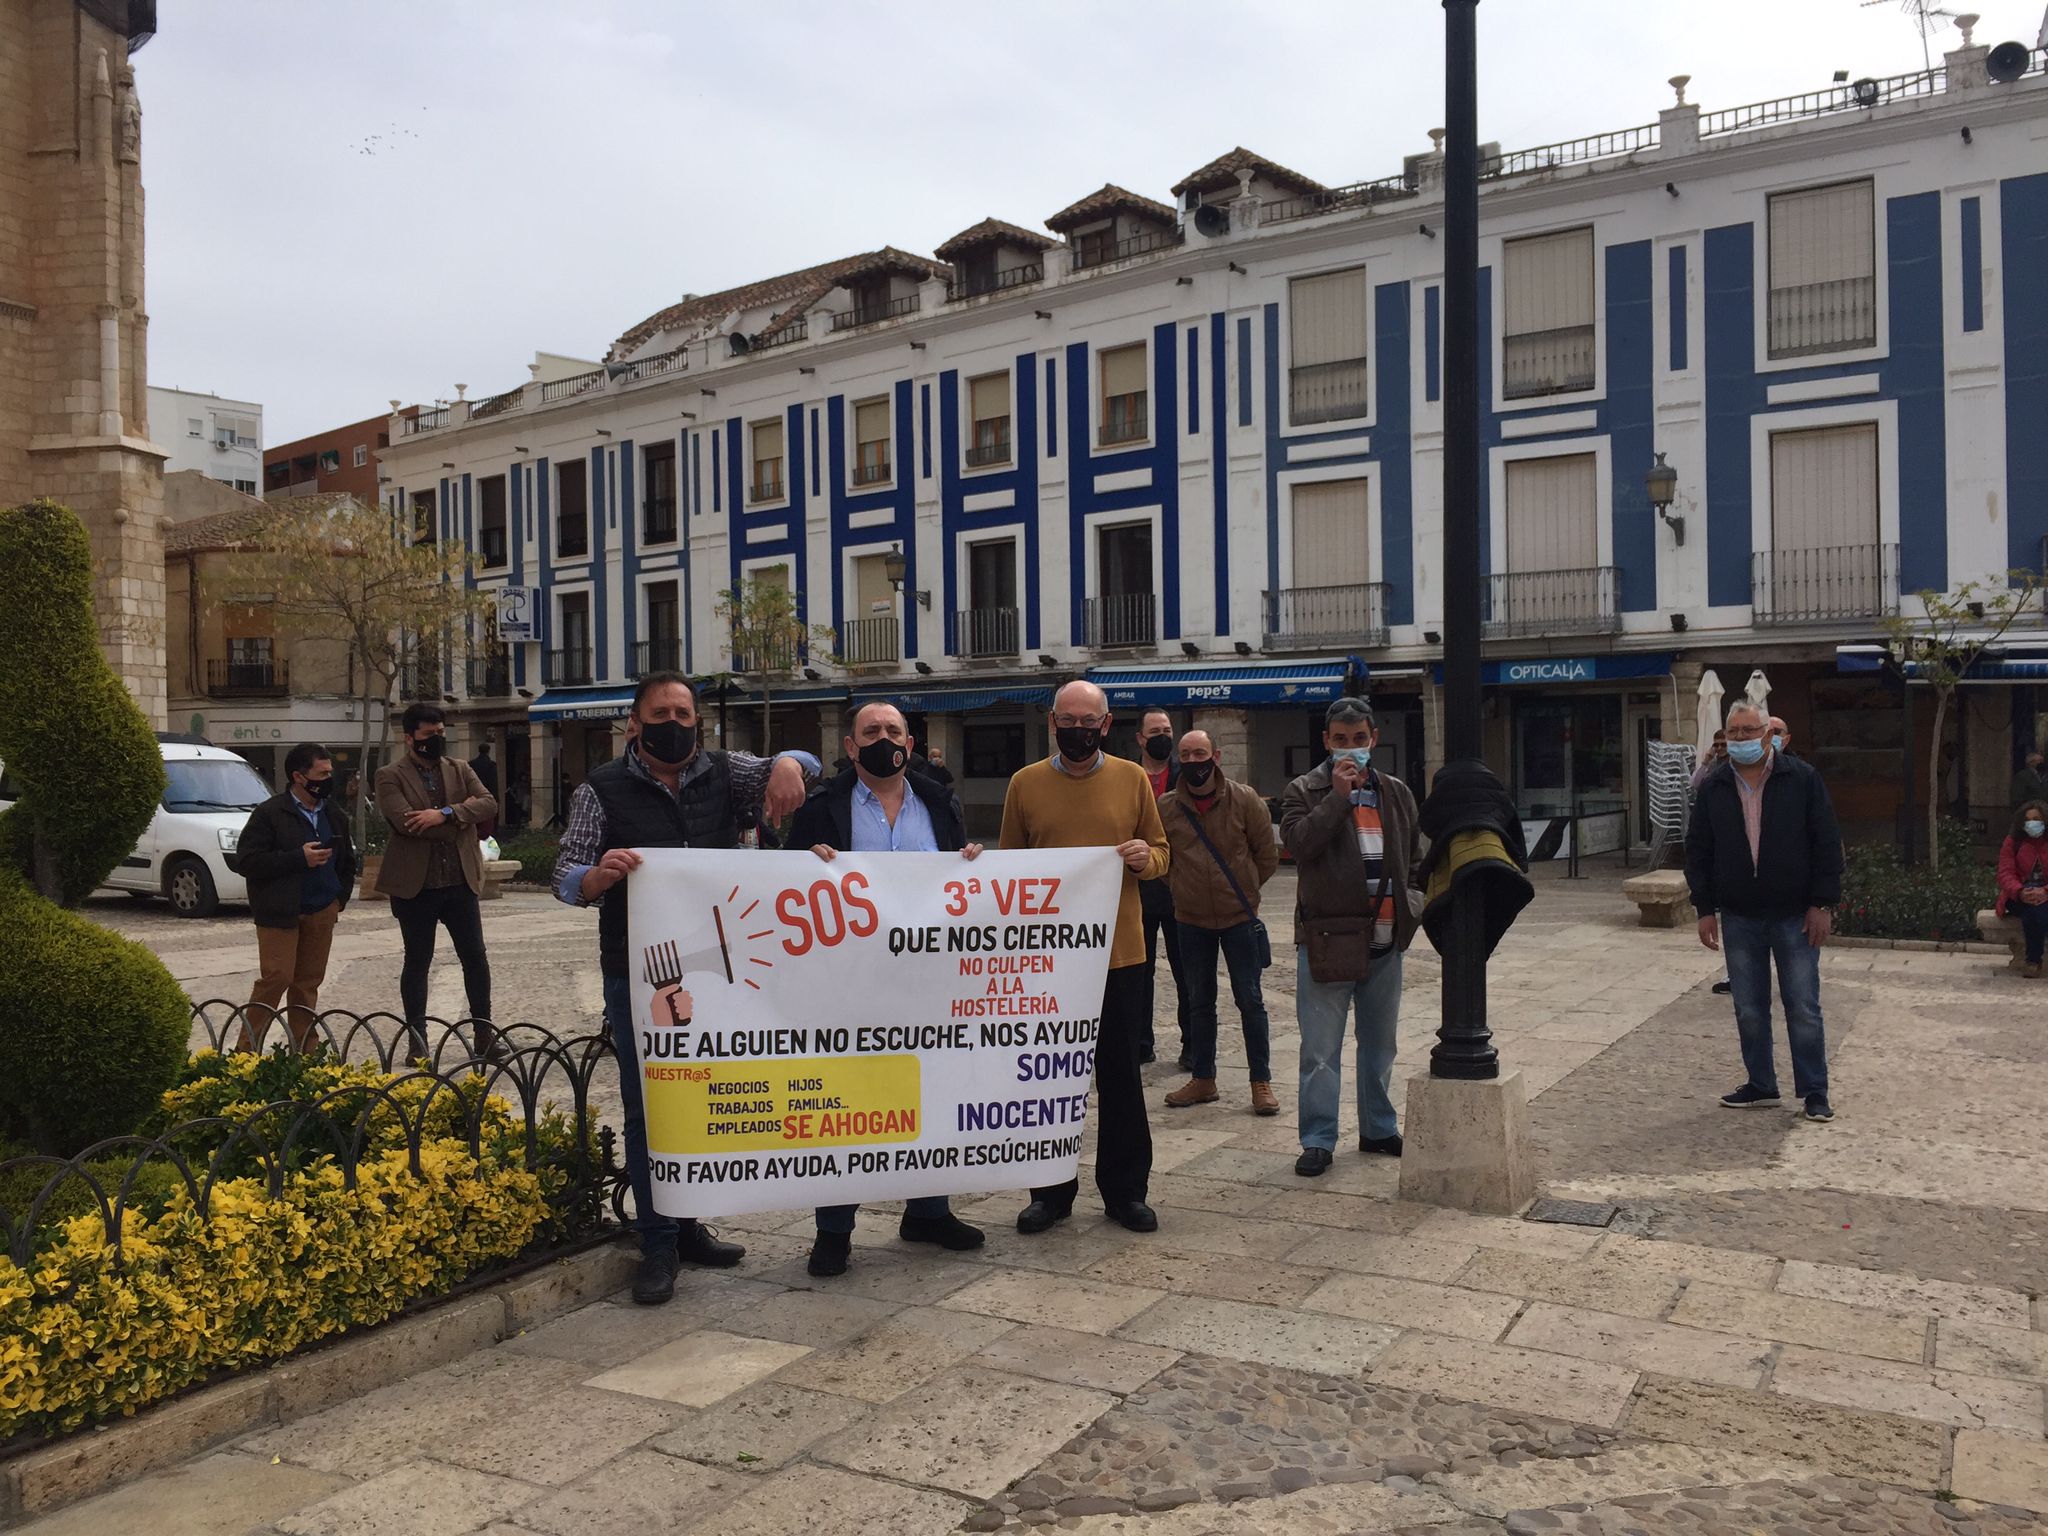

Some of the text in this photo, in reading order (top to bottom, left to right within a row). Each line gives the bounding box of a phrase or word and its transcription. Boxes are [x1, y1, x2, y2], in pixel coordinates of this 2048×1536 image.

[1187, 685, 1232, 699] pepe's
[1304, 687, 1331, 696] AMBAR
[576, 707, 620, 718] TABERNA
[944, 878, 1061, 917] 3ª VEZ
[775, 871, 879, 957] SOS
[888, 923, 1107, 956] QUE NOS CIERRAN
[959, 955, 1054, 976] NO CULPEN
[986, 976, 1024, 995] A LA
[951, 992, 1059, 1017] HOSTELERÍA
[696, 1029, 807, 1058] ALGUIEN
[815, 1028, 849, 1053] NO
[856, 1024, 974, 1052] ESCUCHE,
[981, 1021, 1028, 1047] NOS
[1017, 1047, 1095, 1082] SOMOS
[644, 1067, 712, 1083] NUESTR@S
[708, 1081, 770, 1096] NEGOCIOS
[788, 1078, 823, 1092] HIJOS
[708, 1100, 774, 1115] TRABAJOS
[788, 1097, 849, 1111] FAMILIAS...
[707, 1120, 782, 1135] EMPLEADOS
[783, 1109, 915, 1140] SE AHOGAN
[687, 1159, 759, 1183] FAVOR
[764, 1154, 842, 1180] AYUDA,
[847, 1150, 890, 1174] POR
[895, 1147, 959, 1171] FAVOR
